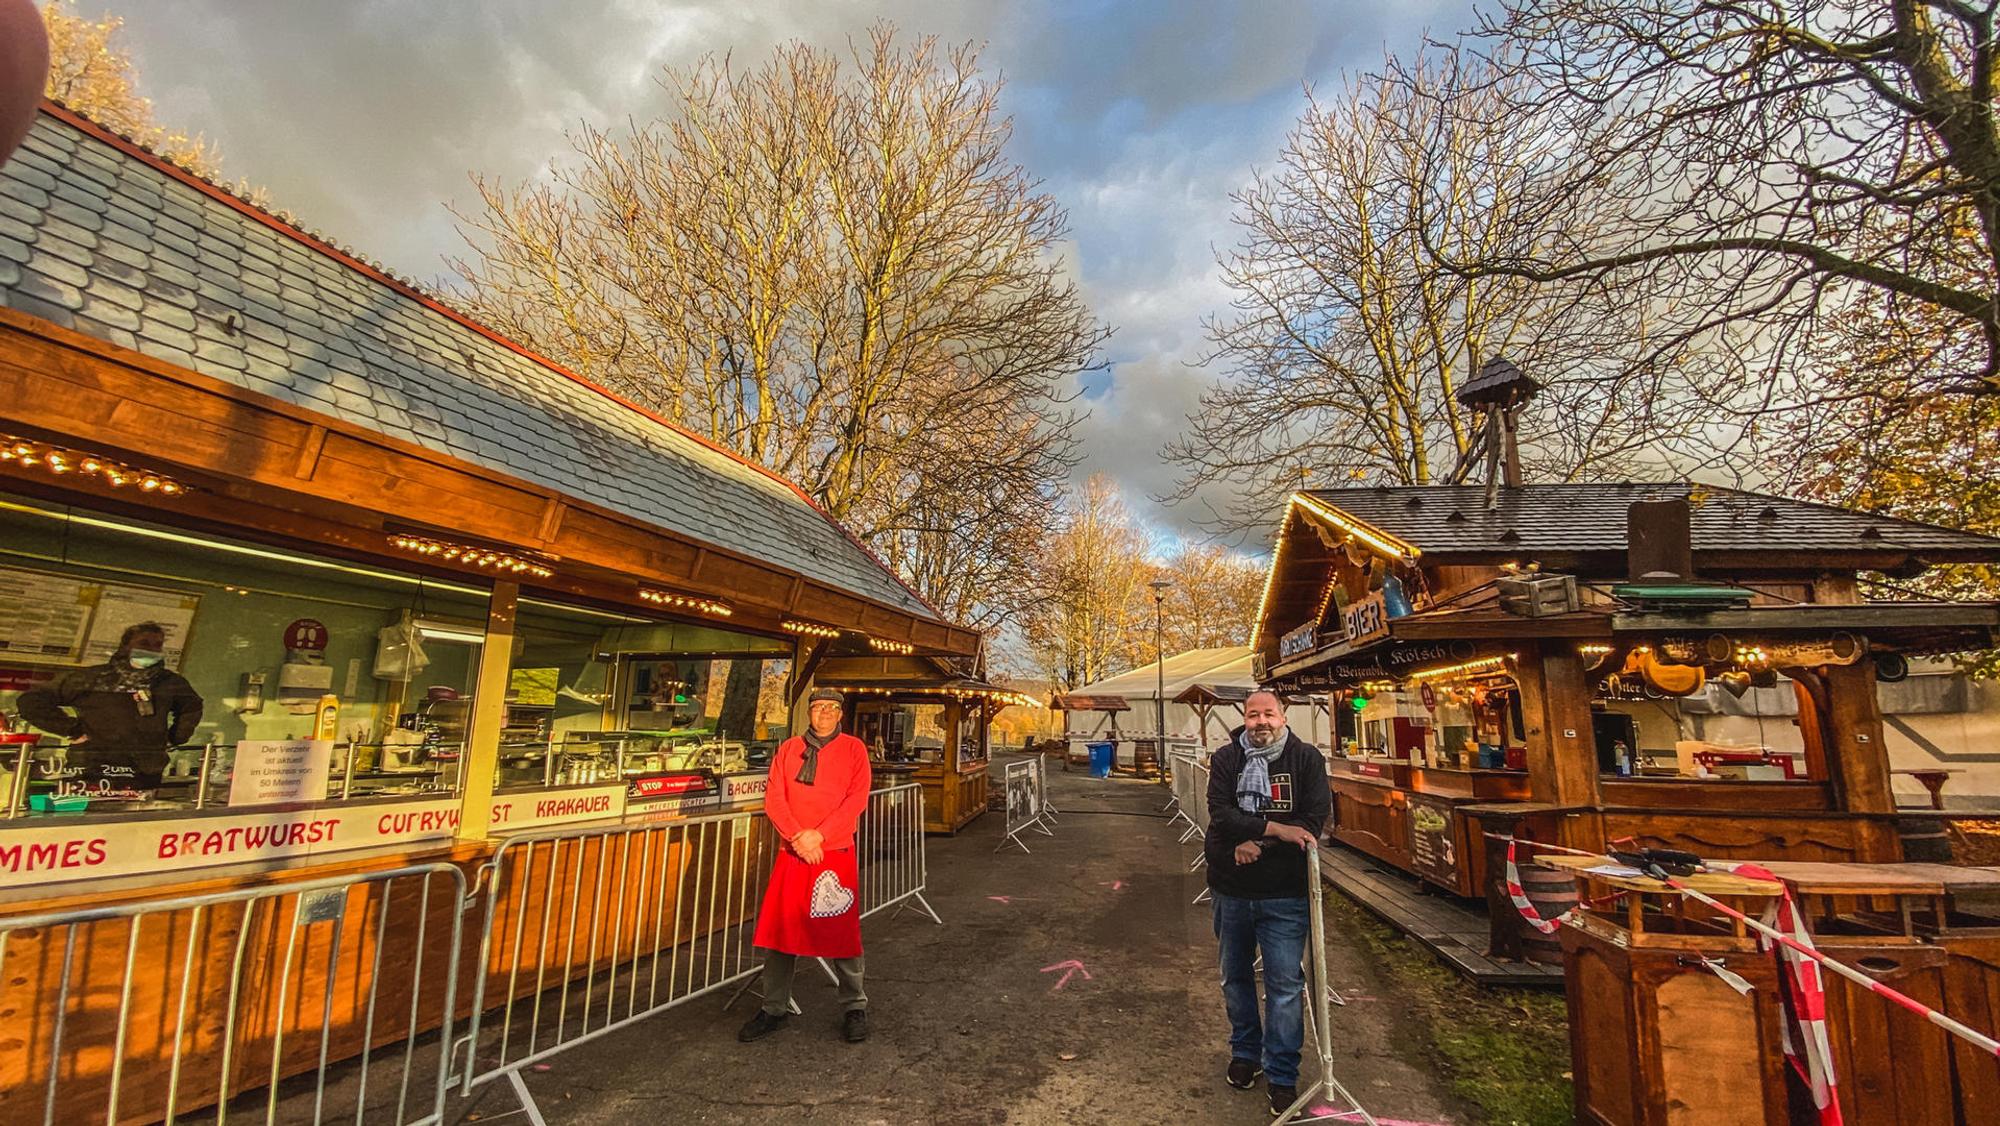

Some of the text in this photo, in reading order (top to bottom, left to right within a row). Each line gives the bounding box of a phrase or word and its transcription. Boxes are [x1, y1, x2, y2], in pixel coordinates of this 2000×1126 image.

[1345, 601, 1382, 640] BIER
[1391, 645, 1446, 664] Kölsch
[40, 755, 136, 775] Nur zum
[260, 779, 271, 787] 50
[641, 781, 663, 791] STOP
[158, 819, 341, 859] BRATWURST
[536, 795, 610, 818] KRAKAUER
